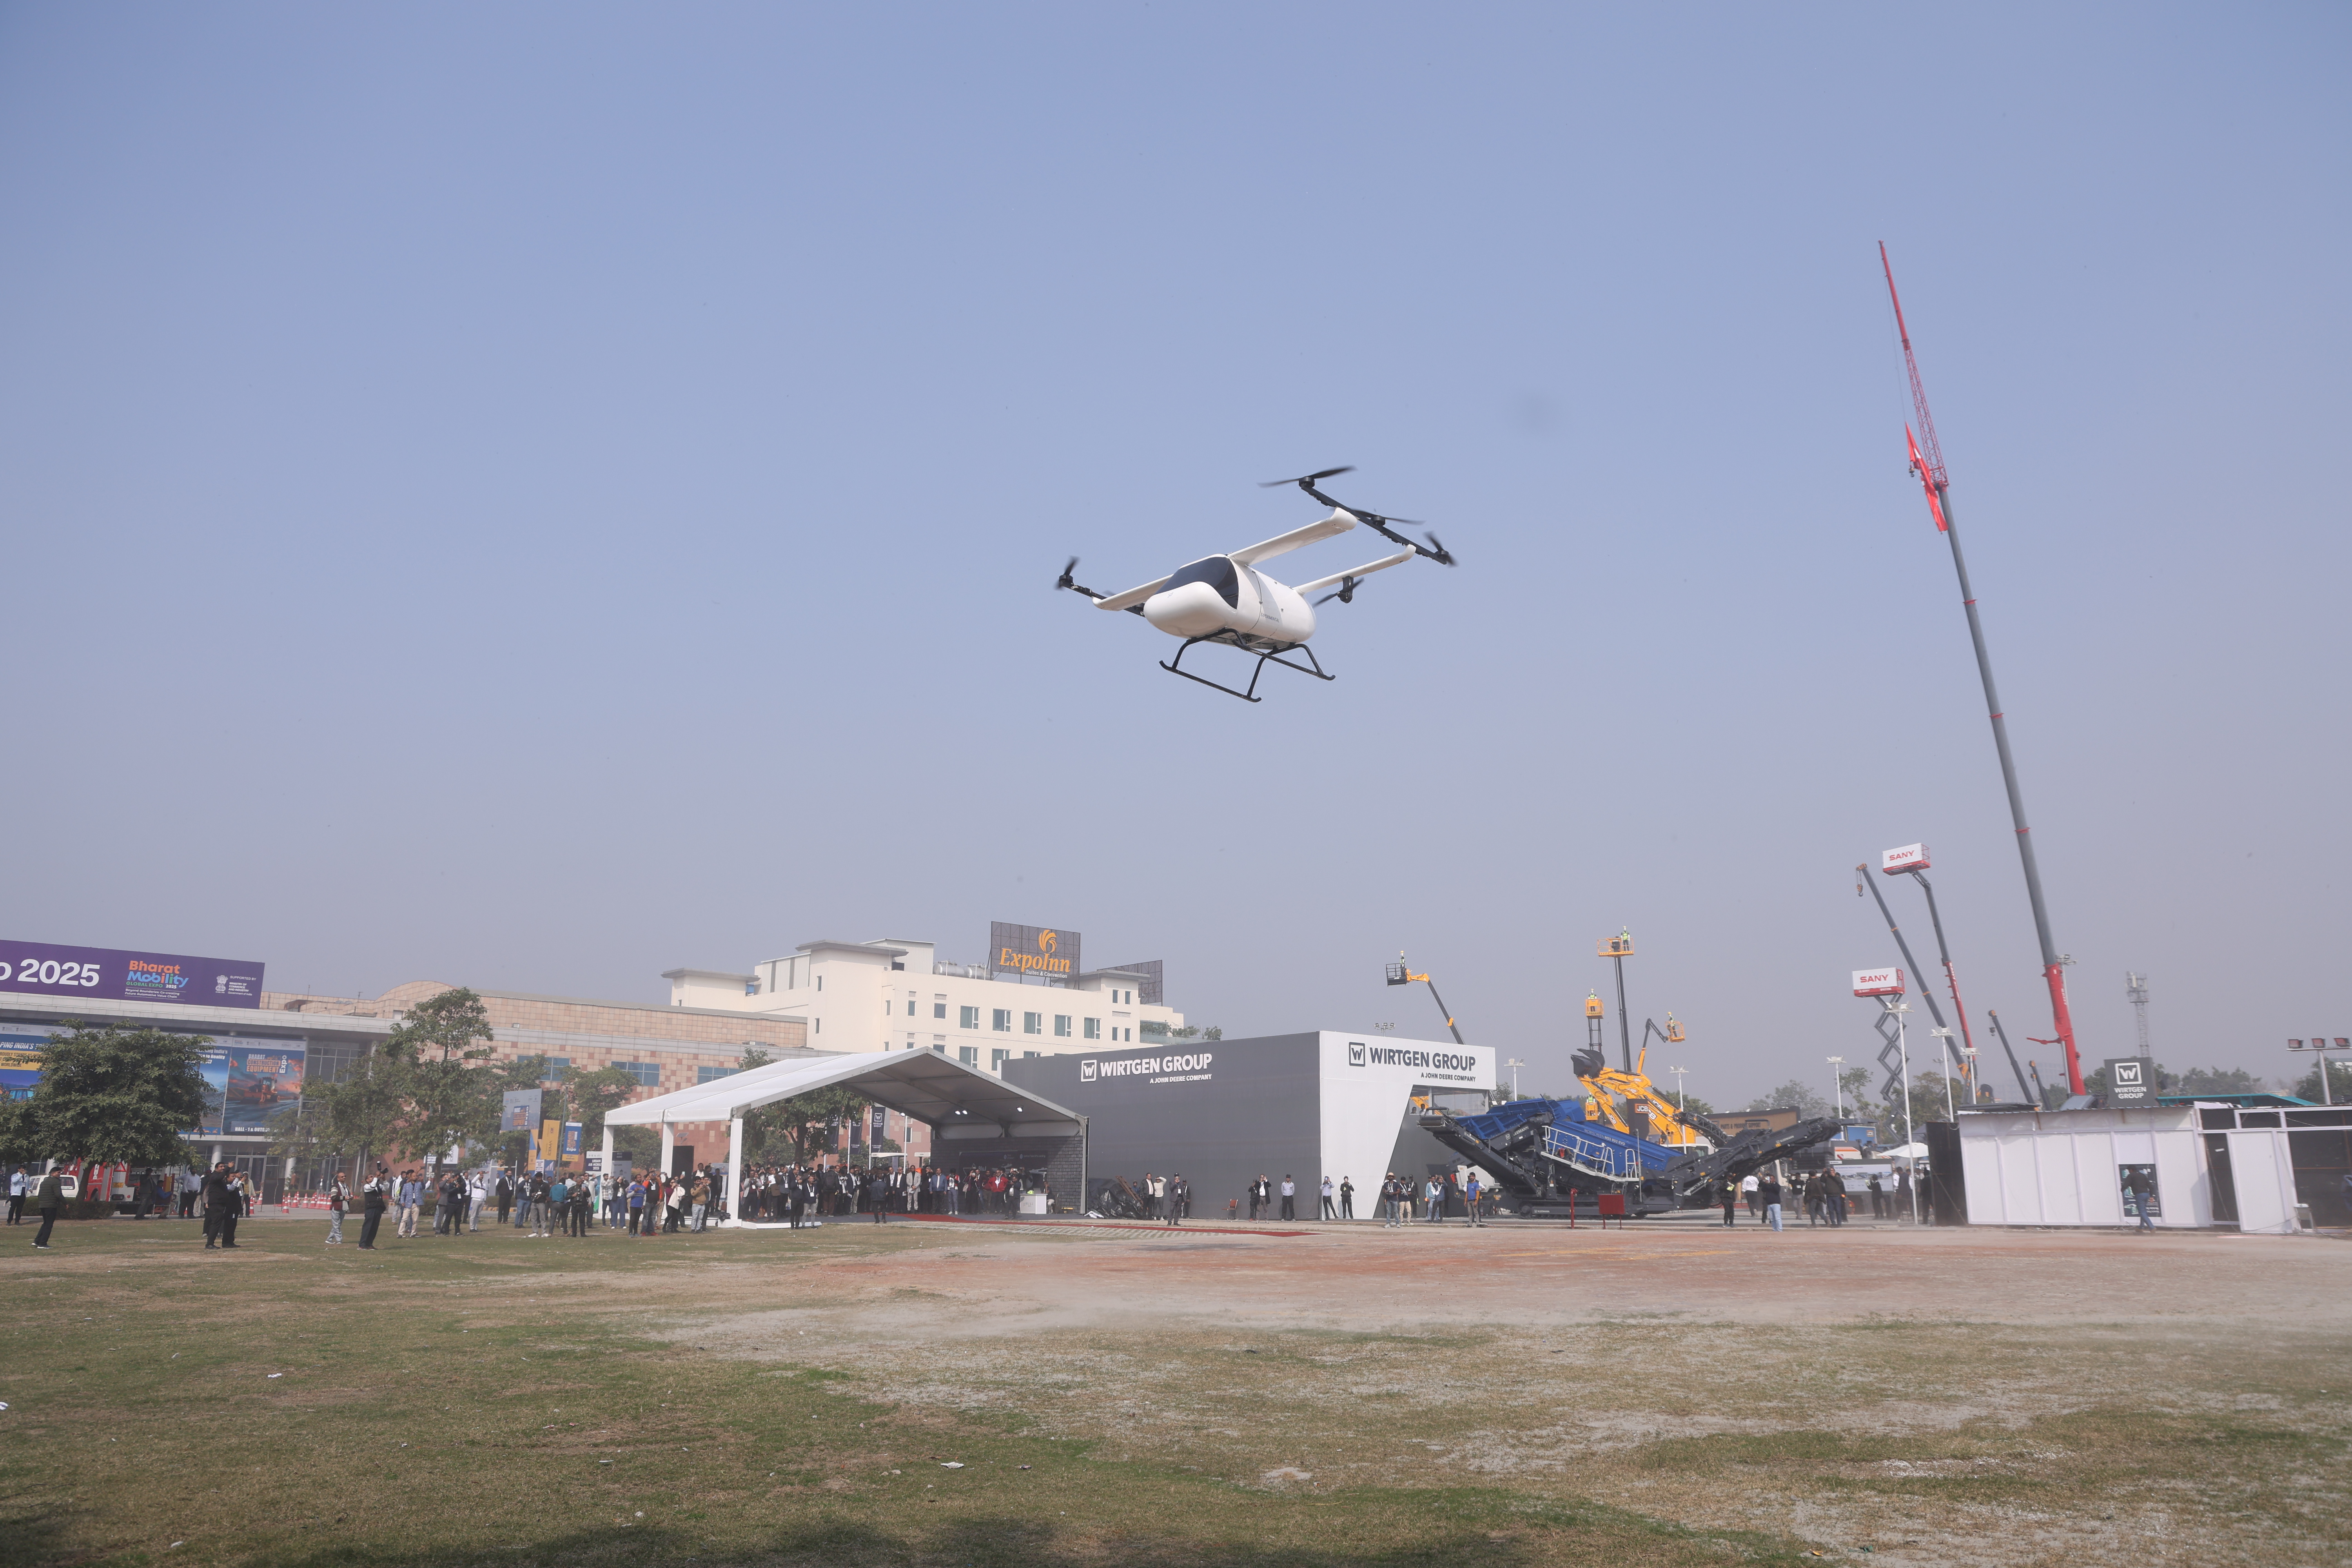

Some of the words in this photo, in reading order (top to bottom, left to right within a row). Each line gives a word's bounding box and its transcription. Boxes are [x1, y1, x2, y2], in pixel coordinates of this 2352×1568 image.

[1261, 613, 1279, 622] EXPERIMENTAL
[1889, 850, 1915, 861] SANY
[129, 960, 180, 974] Bharat
[998, 948, 1070, 973] ExpoInn
[17, 959, 100, 987] 2025
[127, 971, 189, 988] Mobility
[1860, 974, 1889, 983] SANY
[1100, 1058, 1160, 1077] WIRTGEN
[1163, 1053, 1212, 1072] GROUP
[1370, 1047, 1430, 1068] WIRTGEN
[1432, 1053, 1475, 1071] GROUP
[1608, 1114, 1617, 1124] JCB
